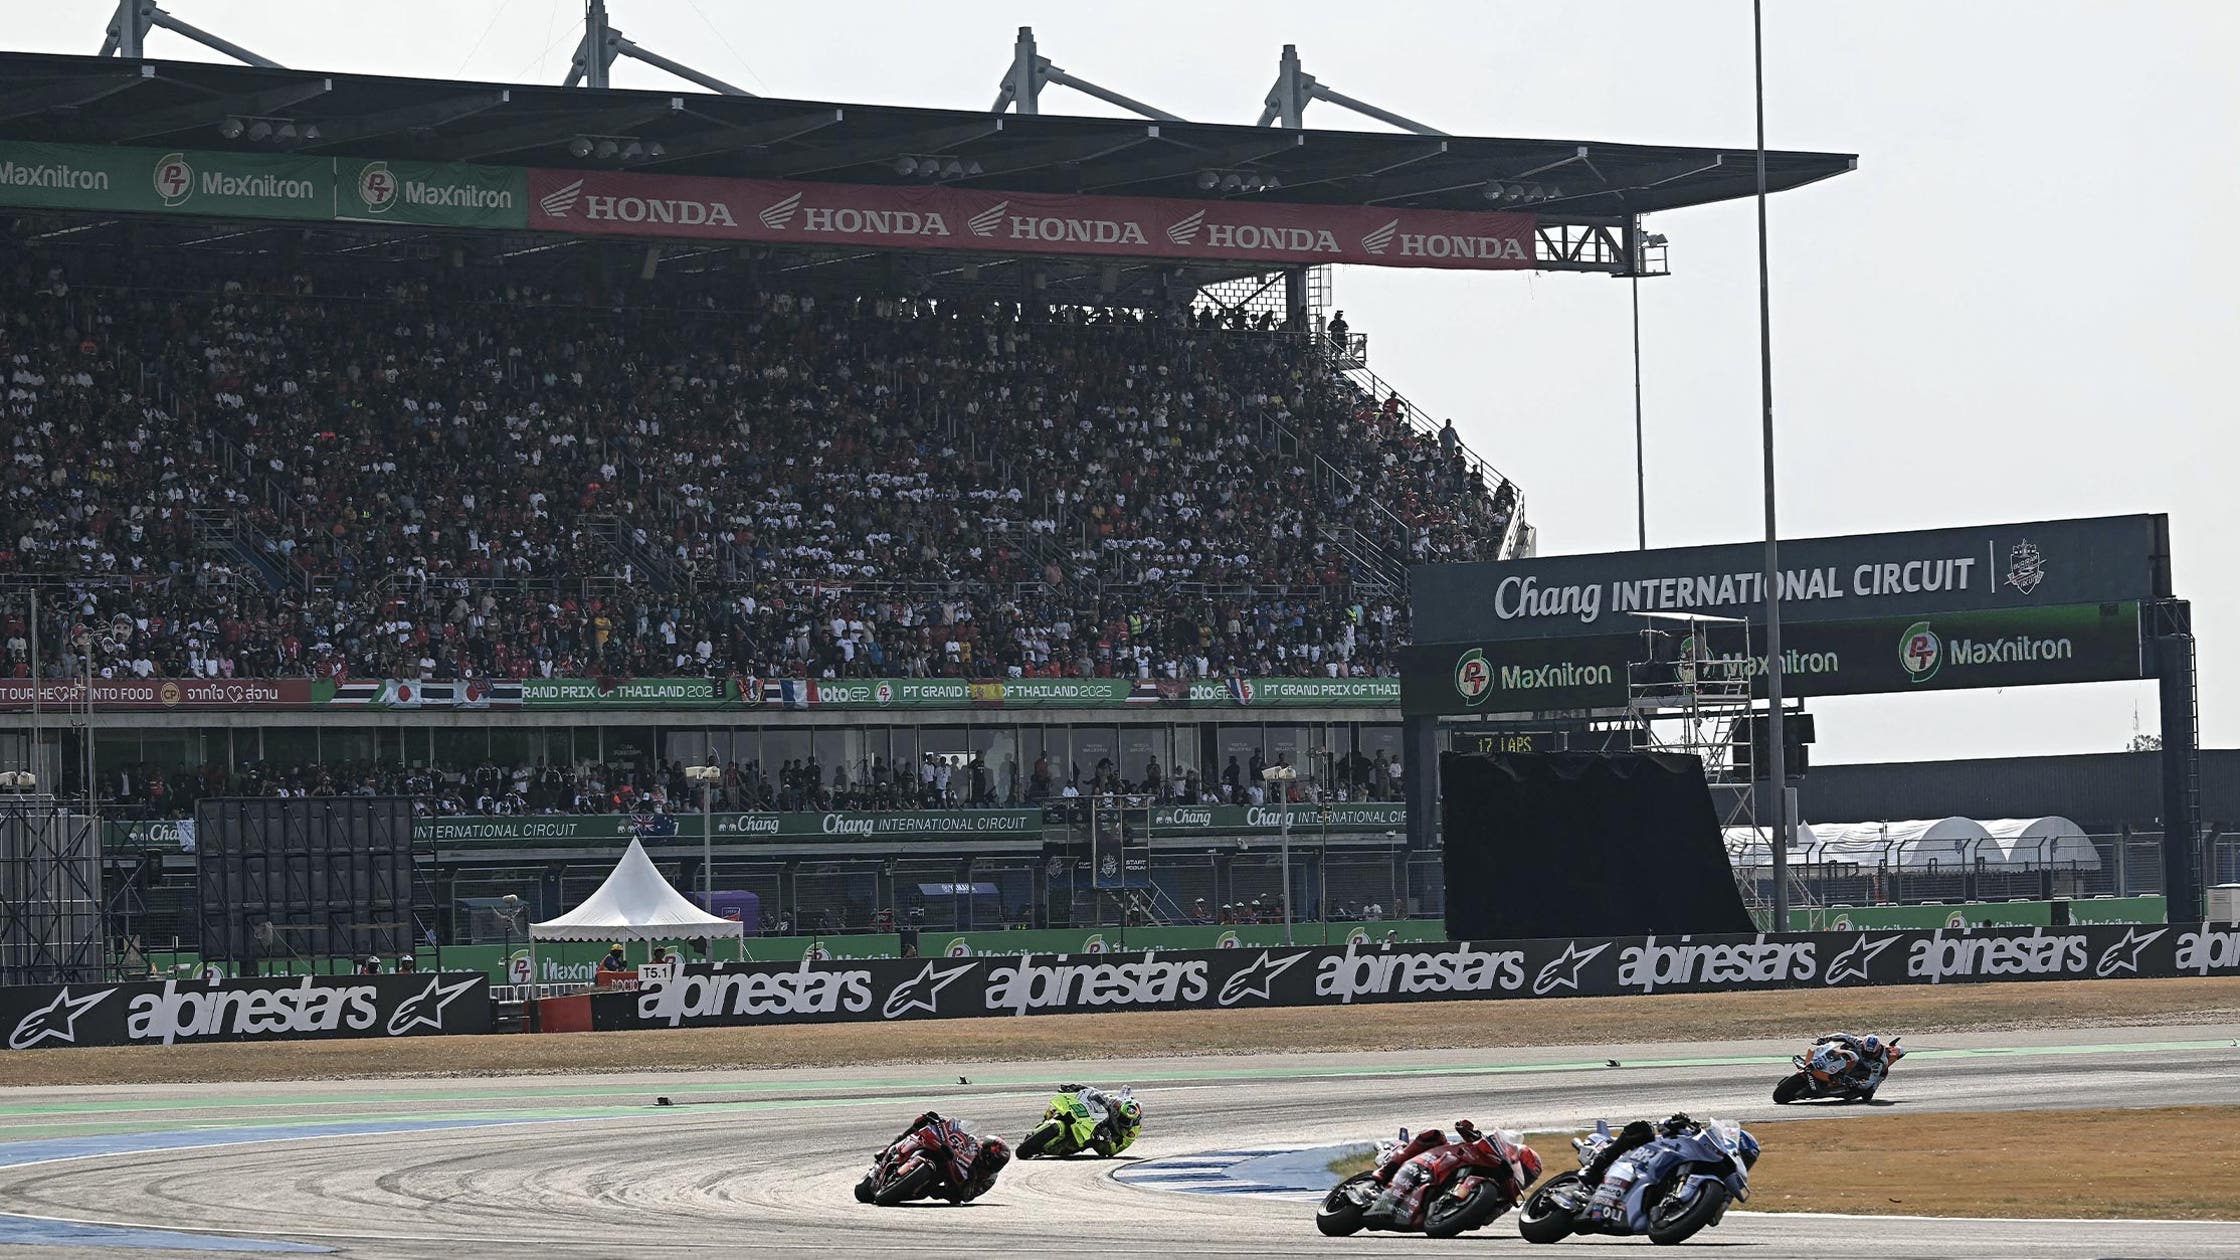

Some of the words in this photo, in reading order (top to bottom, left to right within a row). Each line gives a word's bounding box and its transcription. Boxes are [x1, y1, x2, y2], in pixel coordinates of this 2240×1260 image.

[203, 172, 313, 199] Maxnitron
[405, 182, 511, 209] Maxnitron
[585, 195, 738, 227] HONDA
[803, 208, 950, 236] HONDA
[1009, 216, 1148, 245] HONDA
[1207, 225, 1341, 253] HONDA
[1400, 234, 1527, 260] HONDA
[1495, 576, 1602, 623] Chang
[1853, 557, 1975, 596] CIRCUIT
[1950, 636, 2071, 665] Maxnitron
[1501, 662, 1612, 690] Maxnitron
[93, 688, 117, 700] NTO
[121, 688, 153, 700] FOOD
[522, 686, 558, 698] RAND
[561, 686, 595, 698] PRIX
[617, 686, 684, 698] THAILAND
[687, 686, 713, 698] 202
[903, 686, 919, 697] PT
[921, 686, 963, 697] GRAND
[1016, 686, 1078, 697] THAILAND
[1080, 686, 1111, 697] 2025
[1264, 685, 1279, 696] PT
[1281, 685, 1319, 696] GRAND
[1321, 685, 1351, 696] PRIX
[1352, 685, 1367, 696] OF
[1368, 685, 1400, 696] THAI
[414, 825, 519, 839] INTERNATIONAL
[523, 824, 577, 837] CIRCUIT
[738, 816, 779, 834] Chang
[822, 814, 874, 837] Chang
[878, 818, 974, 831] INTERNATIONAL
[977, 817, 1027, 830] CIRCUIT
[1173, 809, 1211, 827] Chang
[150, 824, 178, 841] Cha
[1618, 933, 1816, 992] alpinestars
[1908, 927, 2087, 984] alpinestars
[643, 967, 667, 978] T5.1
[985, 952, 1208, 1016] alpinestars
[1315, 942, 1524, 1003] alpinestars
[638, 959, 872, 1026] alpinestars
[127, 975, 377, 1046] alpinestars
